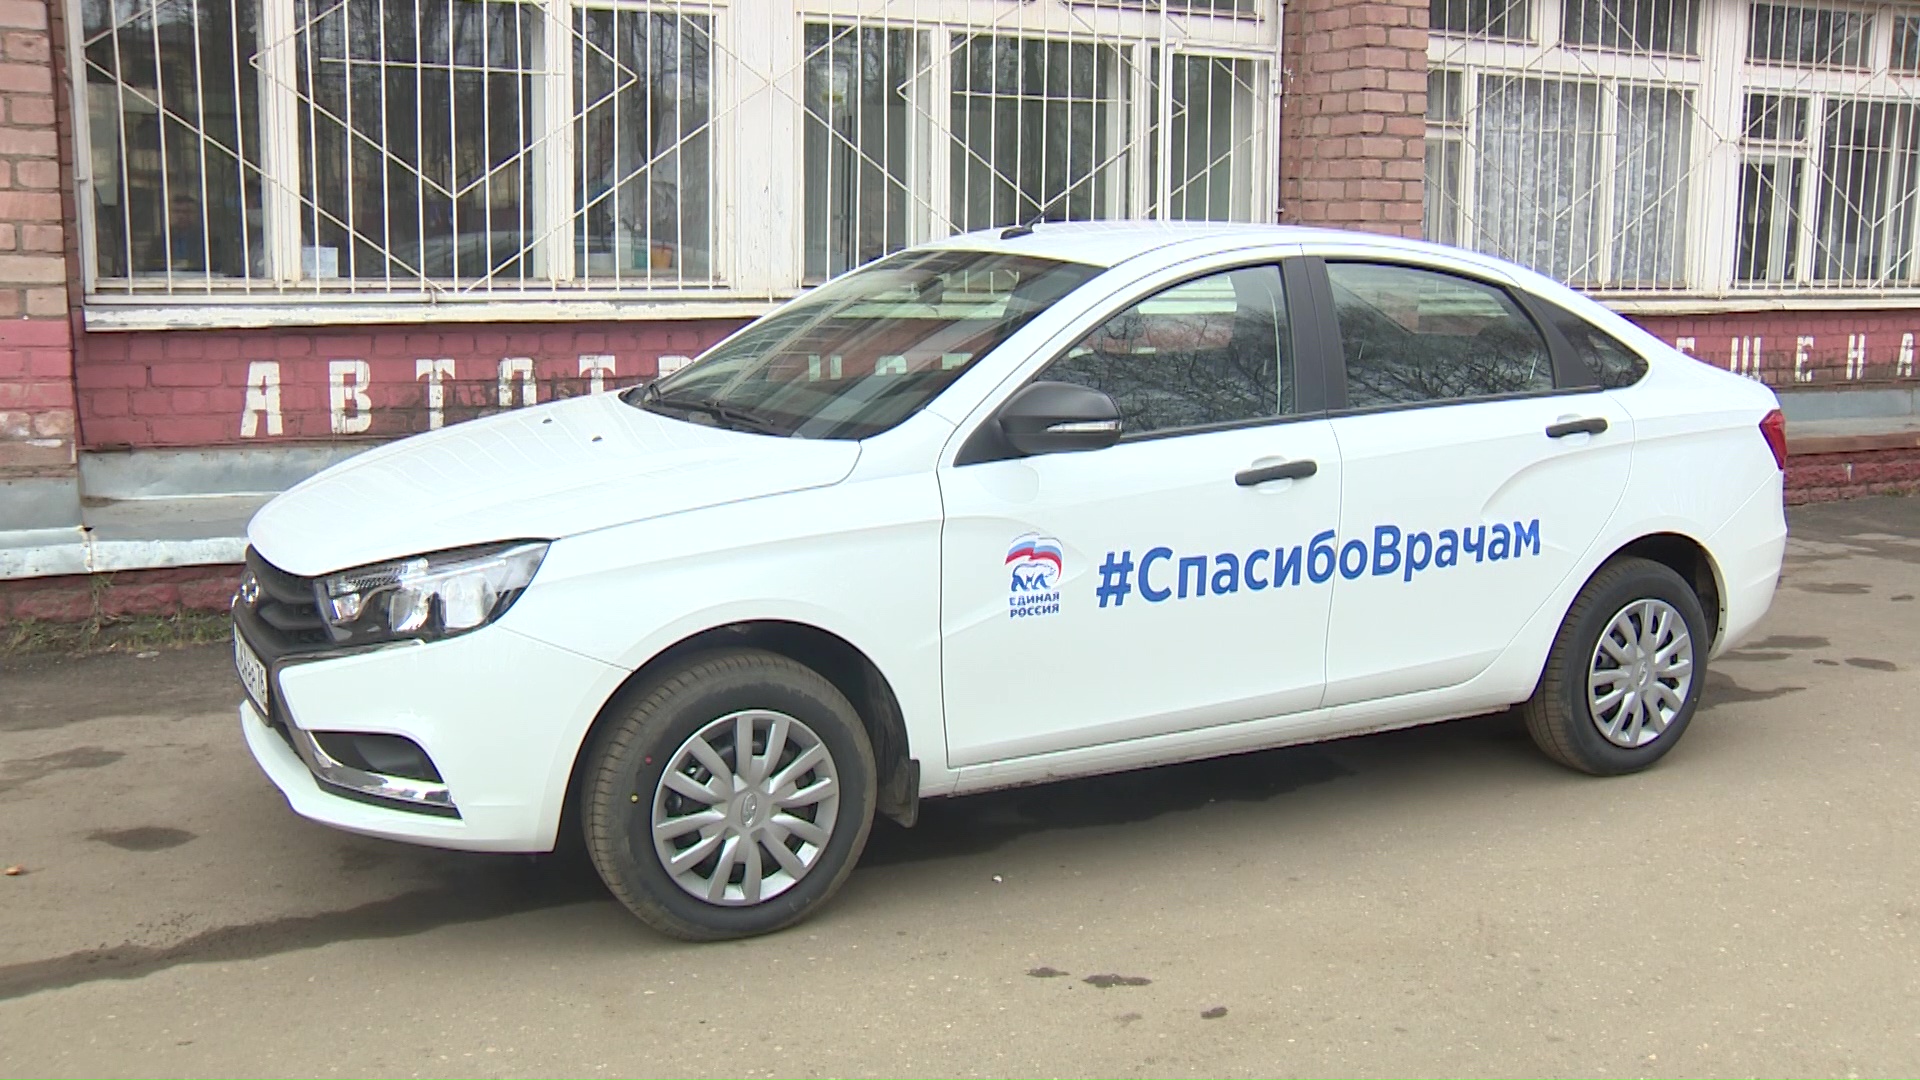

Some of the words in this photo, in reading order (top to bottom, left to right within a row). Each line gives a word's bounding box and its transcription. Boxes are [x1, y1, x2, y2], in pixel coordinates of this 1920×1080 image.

[1095, 518, 1541, 608] #СпасибоВрачам
[1009, 591, 1060, 606] ЕДИНАЯ
[1009, 603, 1060, 618] РОССИЯ
